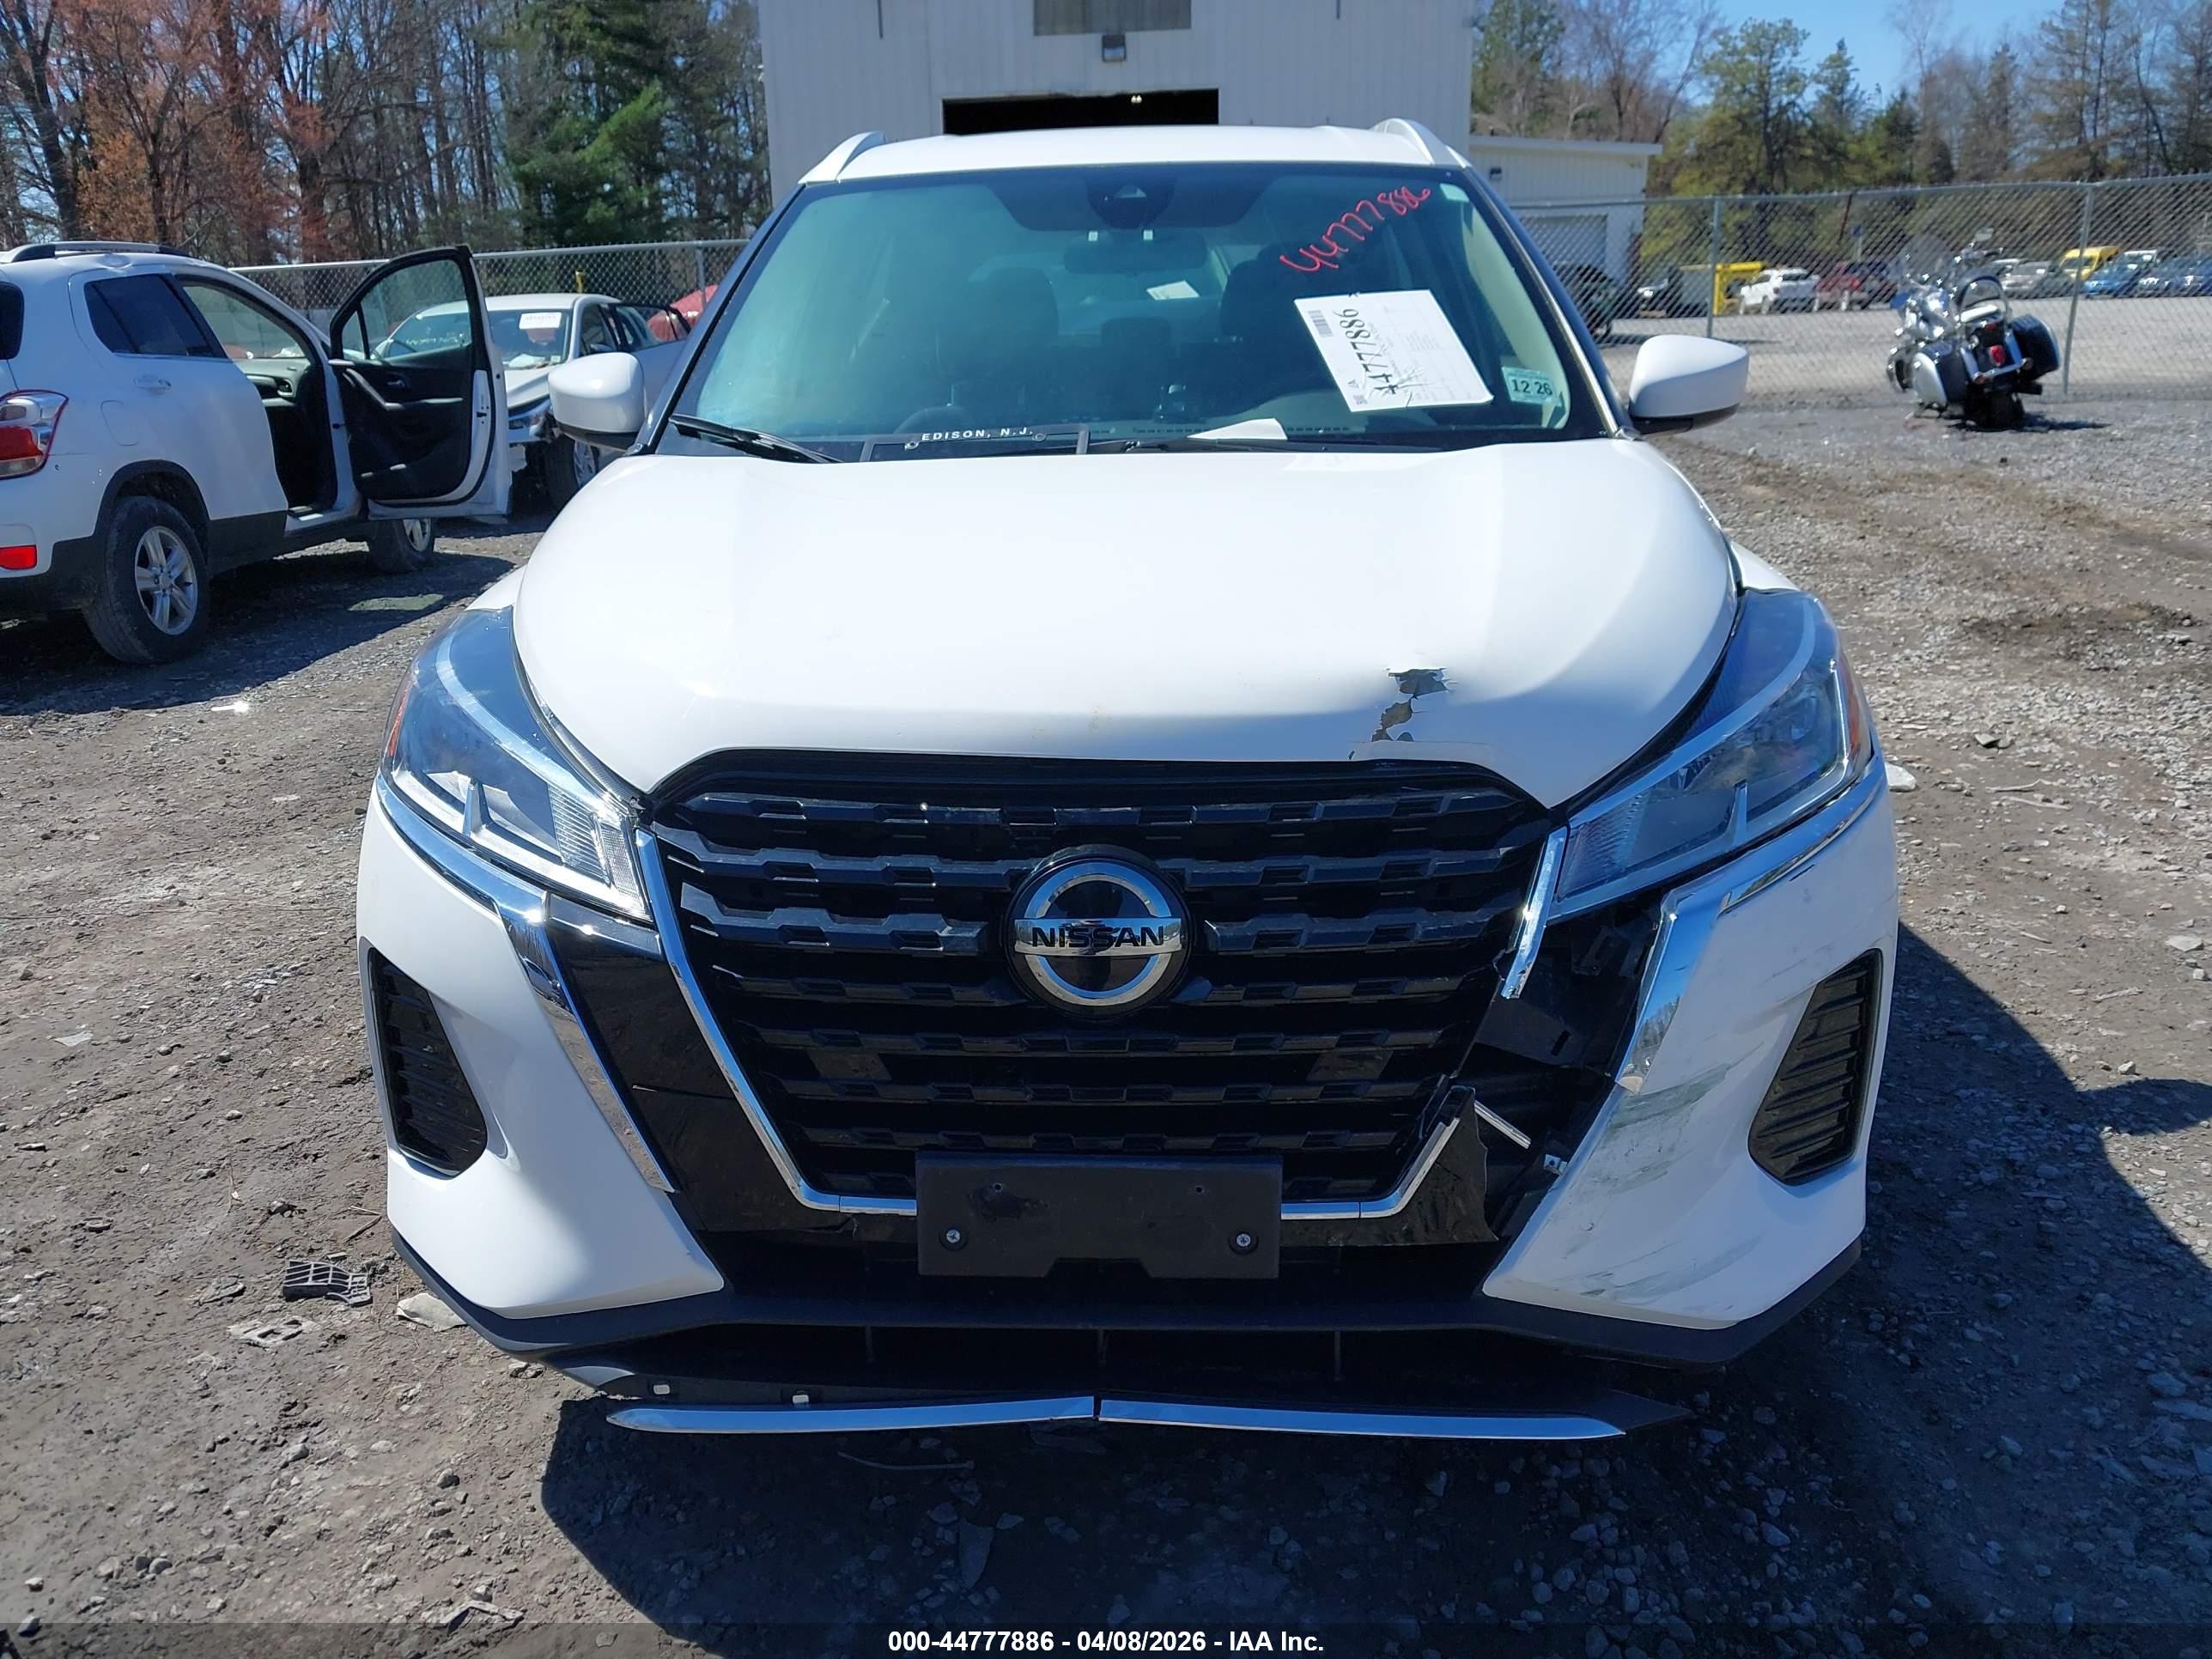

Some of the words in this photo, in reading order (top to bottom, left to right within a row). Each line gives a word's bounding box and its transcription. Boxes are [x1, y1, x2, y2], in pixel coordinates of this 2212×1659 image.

[1279, 185, 1431, 273] 44777886
[1334, 307, 1399, 395] 44777886
[1511, 378, 1531, 393] 12
[1534, 380, 1553, 396] 26
[921, 428, 991, 441] EDISON,
[1000, 426, 1033, 437] N.J.
[1031, 926, 1164, 948] NISSAN
